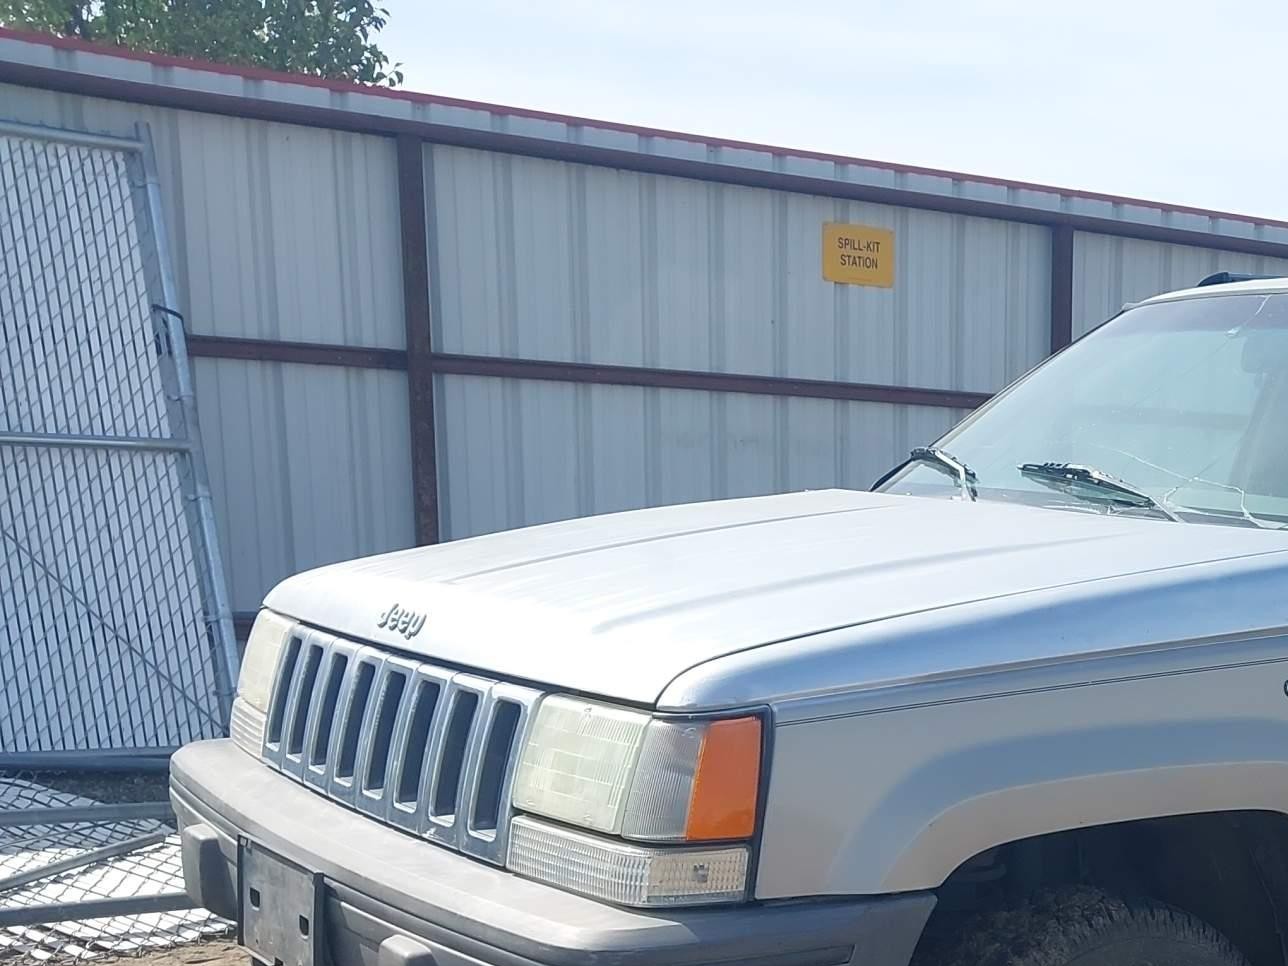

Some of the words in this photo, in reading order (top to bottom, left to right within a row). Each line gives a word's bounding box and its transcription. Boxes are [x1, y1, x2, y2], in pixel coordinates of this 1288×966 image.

[838, 237, 880, 253] SPILL-KIT
[840, 254, 878, 269] STATION
[377, 603, 427, 640] Jeep
